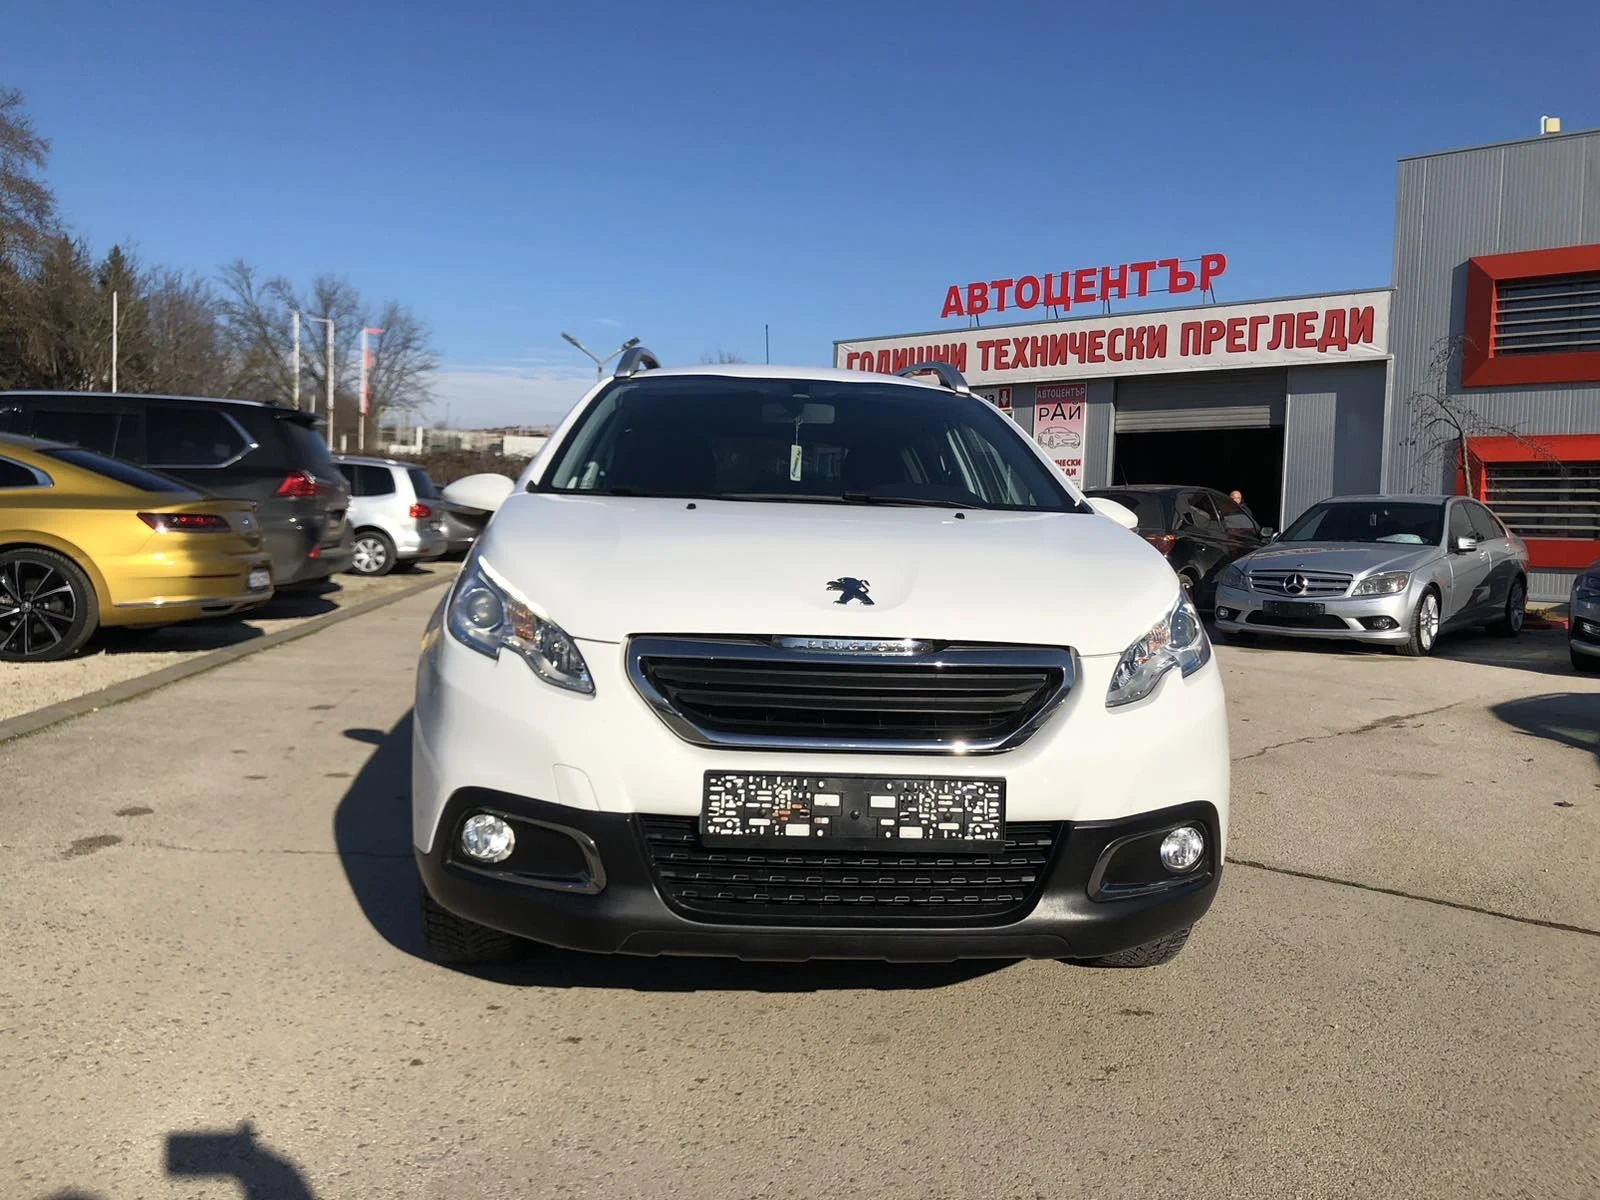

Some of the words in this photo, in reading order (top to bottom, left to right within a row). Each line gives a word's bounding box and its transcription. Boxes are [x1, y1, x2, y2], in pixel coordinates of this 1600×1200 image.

[940, 253, 1226, 318] АВТОЦЕНТЪР
[976, 324, 1168, 372] ТЕХНИЧЕСКИ
[1179, 306, 1375, 357] ПРЕГЛЕДИ
[1037, 387, 1085, 398] АВТОЦЕНТЪР
[1038, 401, 1081, 422] РАЙ
